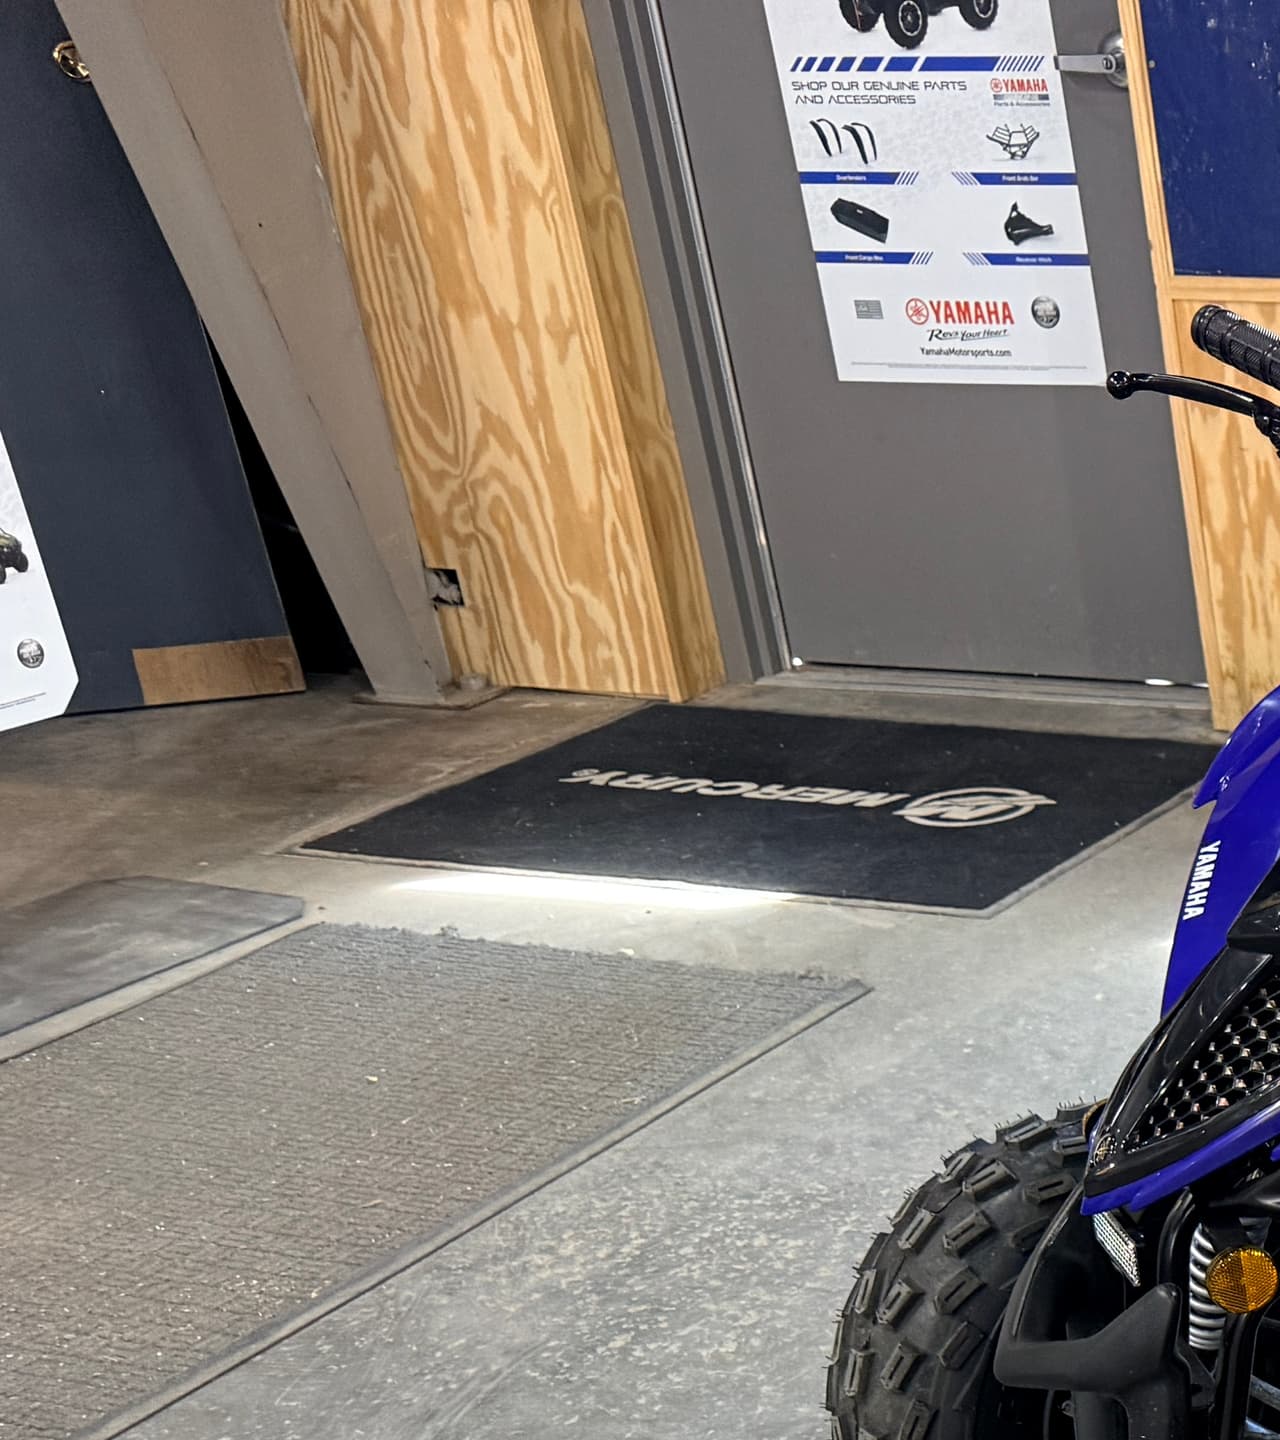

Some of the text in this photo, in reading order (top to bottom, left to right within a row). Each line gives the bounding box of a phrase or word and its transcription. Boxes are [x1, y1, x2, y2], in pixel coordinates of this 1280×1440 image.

[791, 81, 967, 91] SHOP OUR GENUINE PARTS
[1002, 78, 1048, 92] YAMAHA
[795, 95, 916, 104] AND ACCESSORIES
[929, 300, 1015, 326] YAMAHA
[926, 328, 959, 342] Revs
[960, 330, 982, 341] Your
[919, 347, 1012, 358] YamahaMotorsports.com
[559, 769, 911, 807] MERCURY
[1182, 839, 1221, 920] YAMAHA
